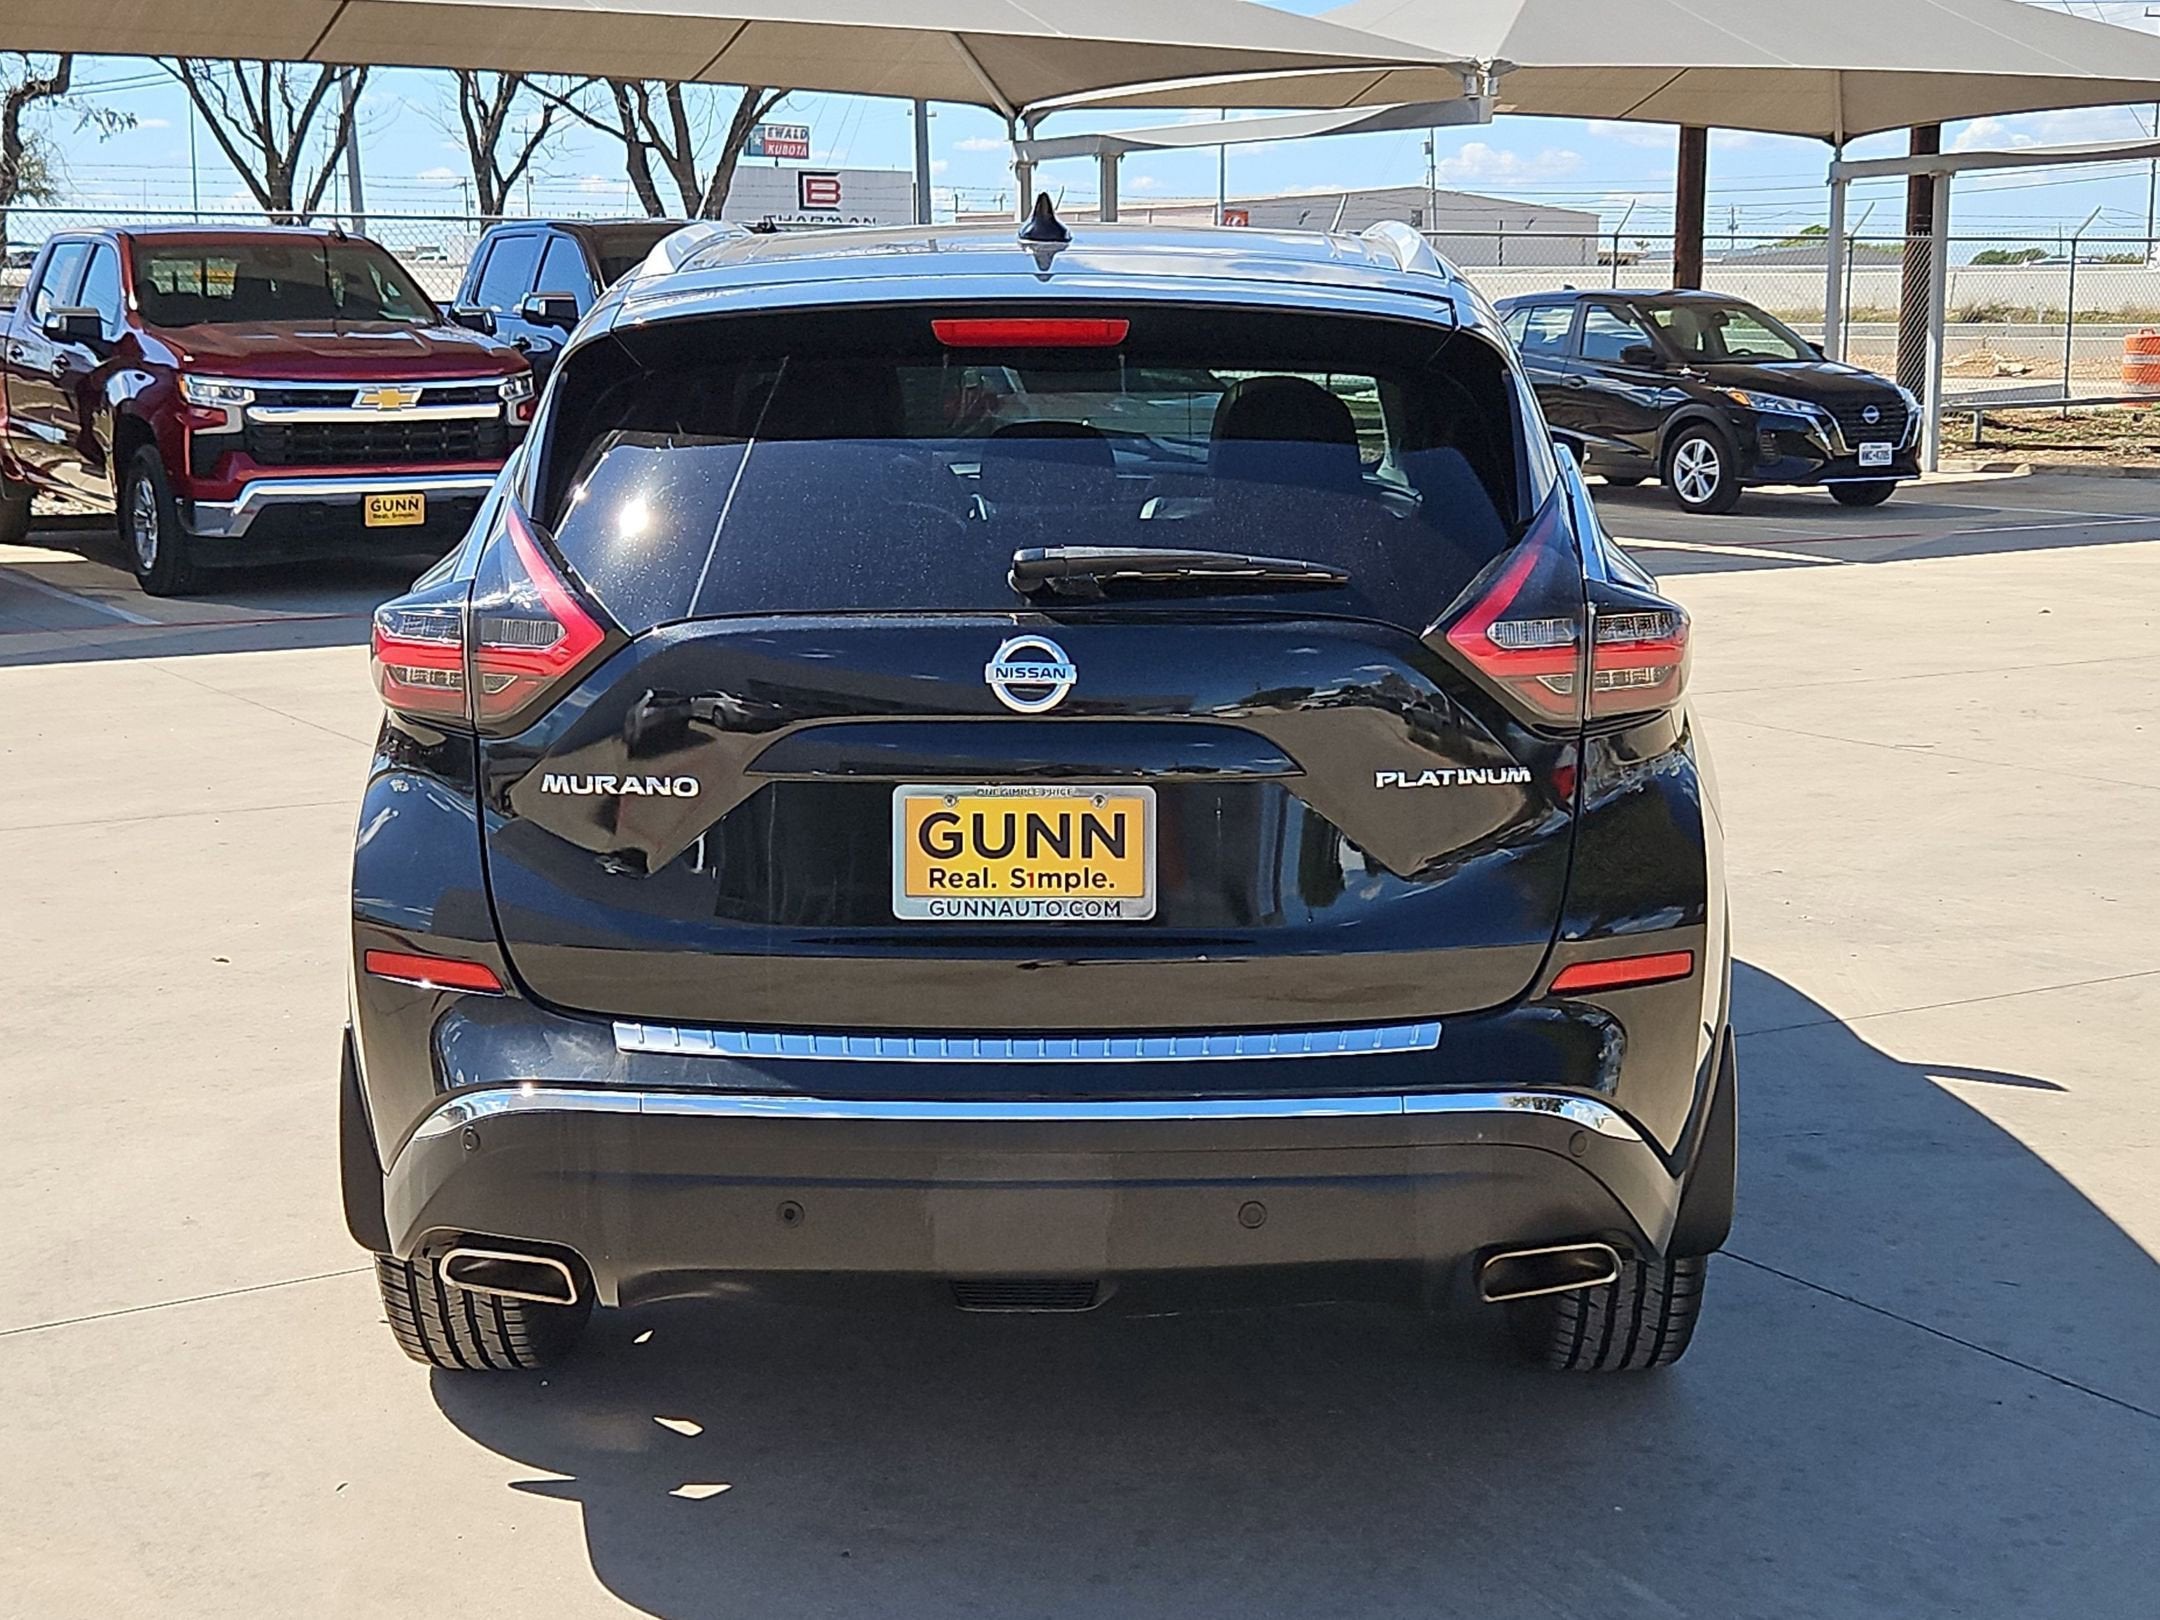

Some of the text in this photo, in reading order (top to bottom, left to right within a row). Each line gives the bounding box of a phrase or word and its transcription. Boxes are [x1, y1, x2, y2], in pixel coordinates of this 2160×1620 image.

[767, 126, 808, 140] EWALD
[767, 144, 807, 156] KUBOTA
[371, 498, 419, 512] GUNN
[995, 667, 1066, 679] NISSAN
[541, 773, 700, 798] MURANO
[1375, 766, 1532, 788] PLATINUM
[918, 812, 1126, 860] GUNN
[928, 866, 998, 889] Real.
[929, 900, 1121, 918] GUNNAUTO.COM
